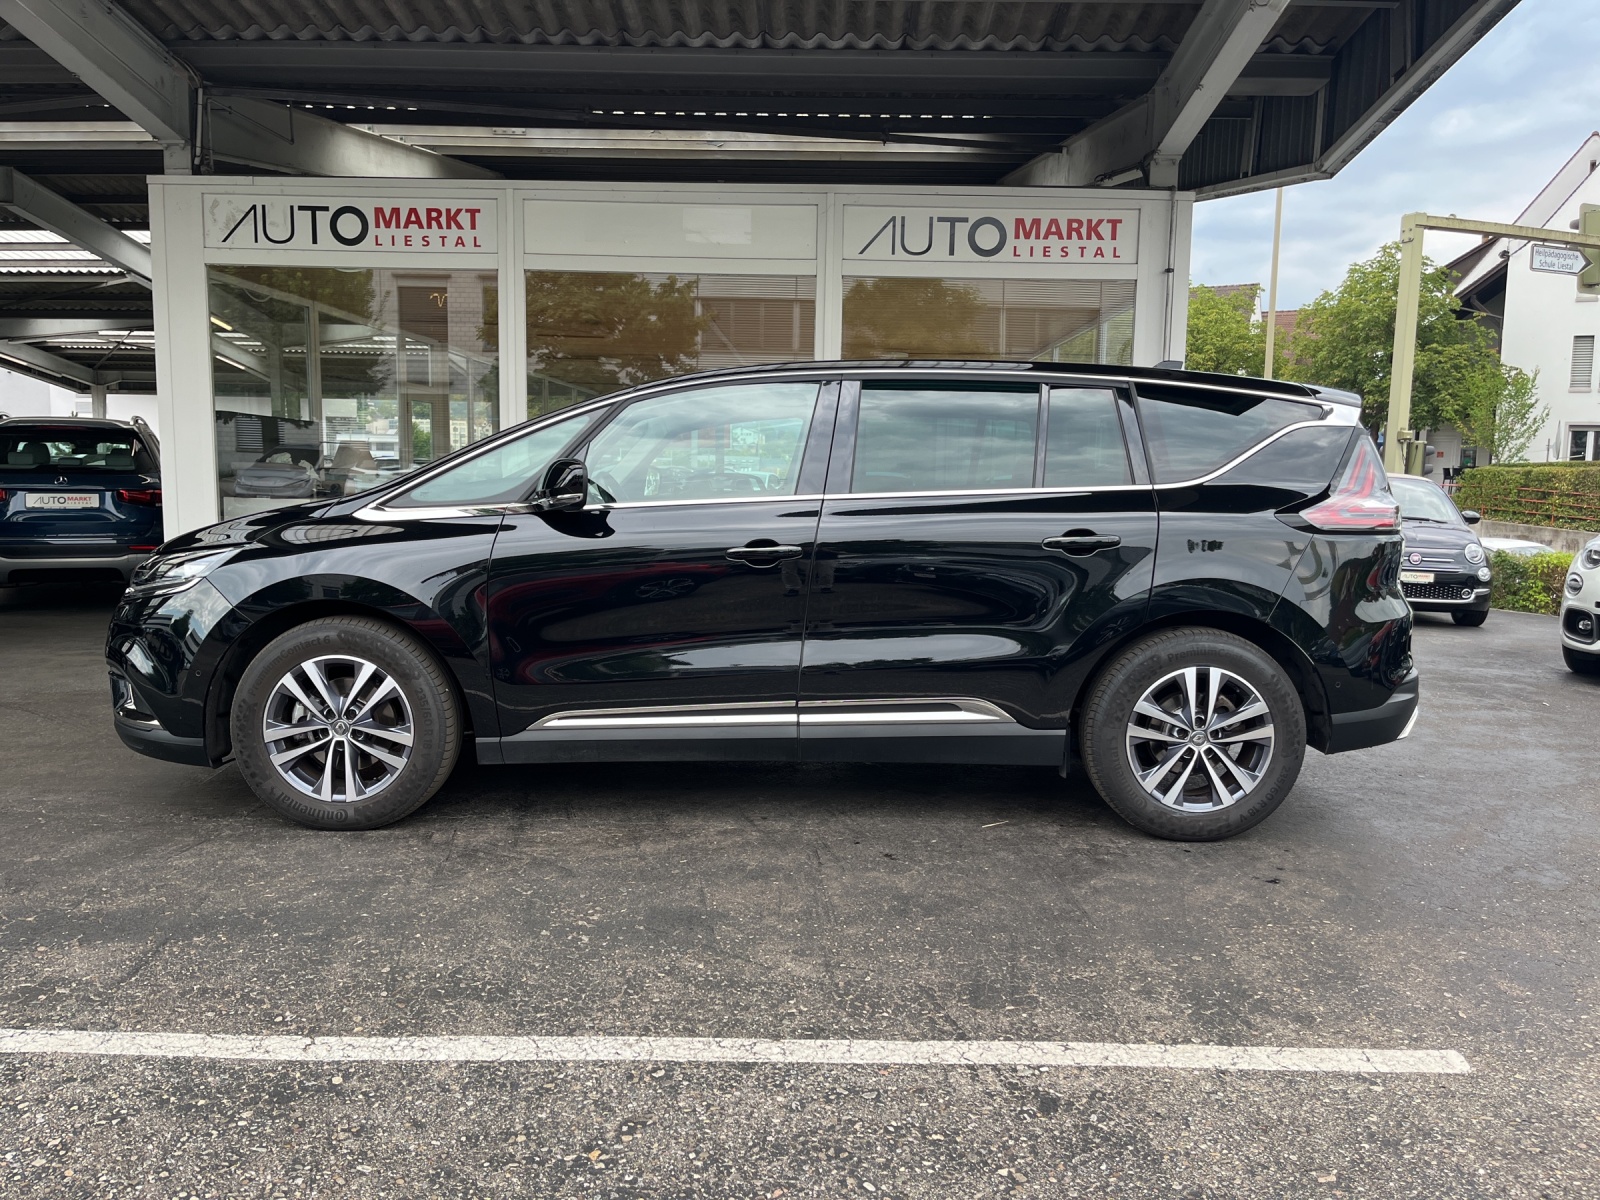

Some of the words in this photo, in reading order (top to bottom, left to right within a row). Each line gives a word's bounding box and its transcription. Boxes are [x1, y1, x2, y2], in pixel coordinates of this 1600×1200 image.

[221, 204, 369, 247] AUTO
[374, 207, 481, 230] MARKT
[374, 234, 482, 248] LIESTAL
[858, 215, 1007, 257] AUTO
[1014, 218, 1122, 241] MARKT
[1012, 245, 1121, 258] LIESTAL
[1535, 249, 1579, 261] Heilpädagogische
[1539, 260, 1556, 269] Schule
[1557, 261, 1574, 270] Liestal
[33, 496, 66, 504] AUTO
[276, 792, 349, 822] Continental
